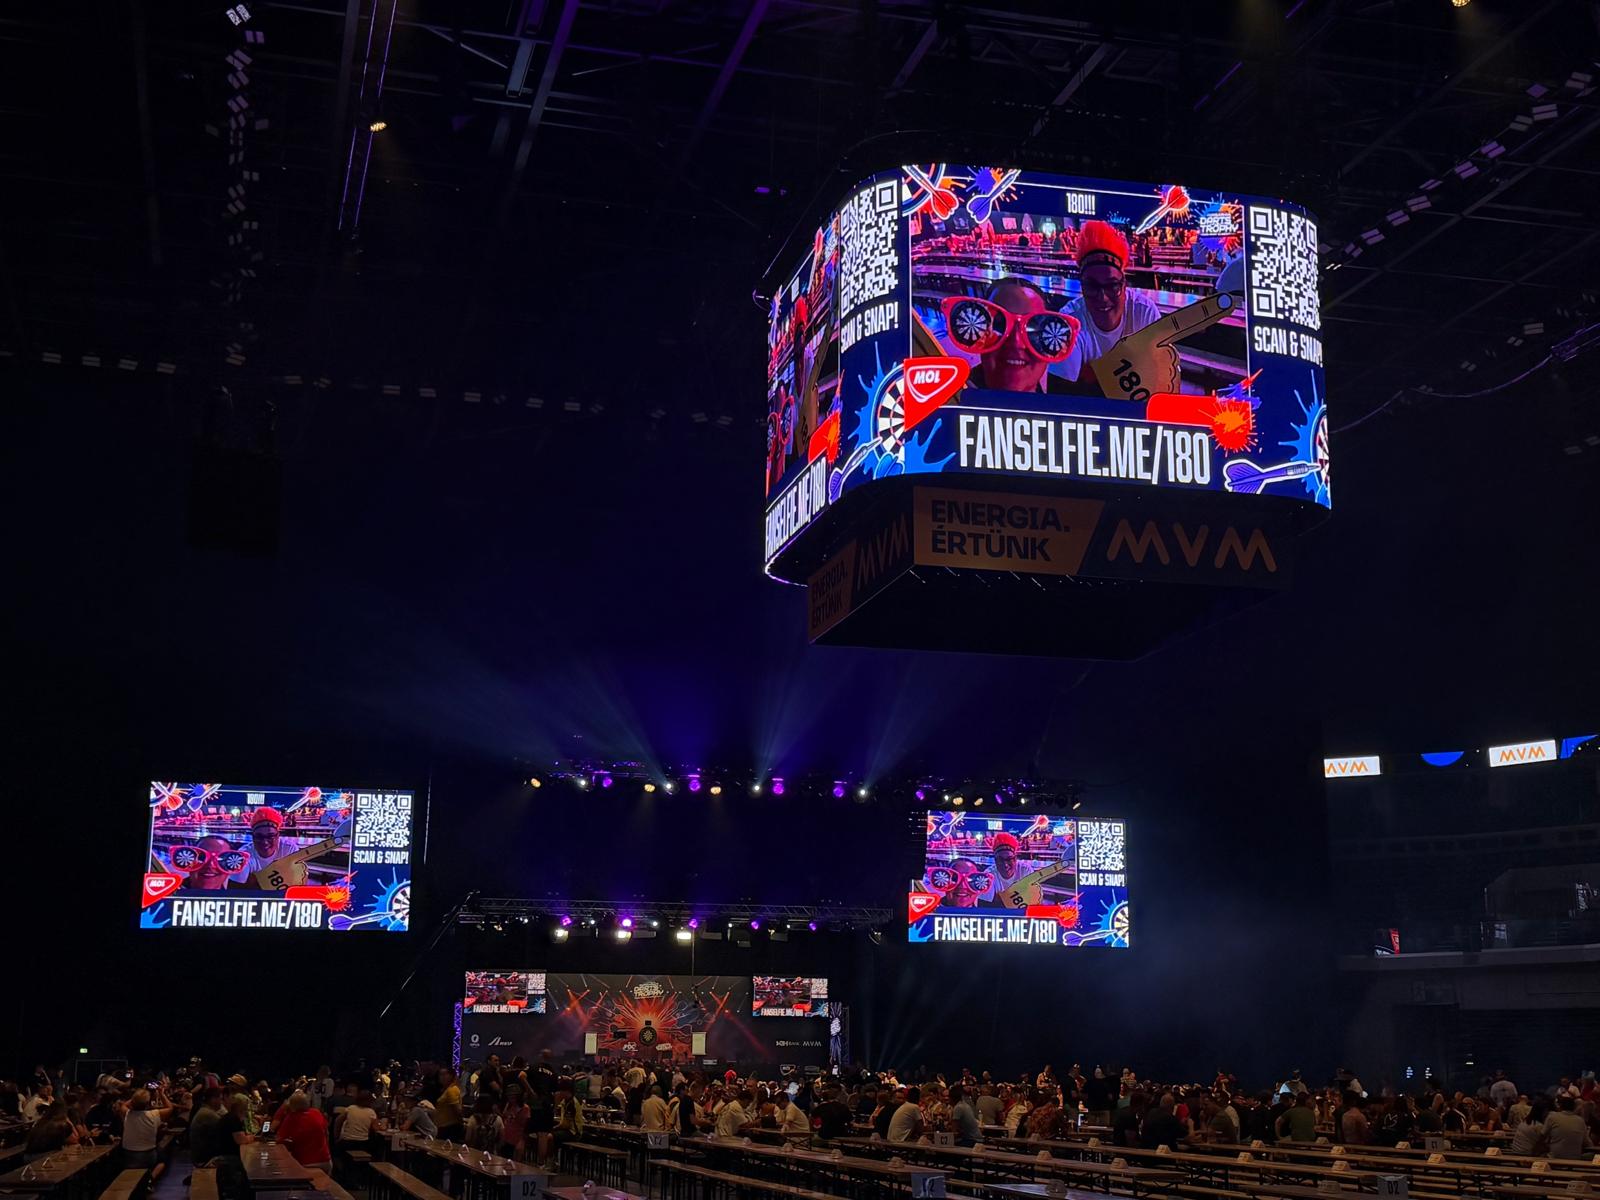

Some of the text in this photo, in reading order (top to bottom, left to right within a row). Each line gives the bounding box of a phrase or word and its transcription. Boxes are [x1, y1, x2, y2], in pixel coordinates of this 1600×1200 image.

[1066, 193, 1096, 217] 180!!!
[1200, 224, 1239, 234] TROPHY
[864, 301, 899, 338] SNAP!
[1254, 326, 1289, 355] SCAN
[1290, 331, 1298, 356] &
[913, 370, 941, 385] MOL
[959, 414, 1211, 485] FANSELFIE.ME/180
[931, 500, 1071, 533] ENERGIA.
[931, 525, 1051, 562] ÉRTÜNK
[1106, 518, 1278, 573] MVM
[1499, 744, 1546, 763] MVM
[354, 851, 375, 864] SCAN
[172, 900, 322, 929] FANSELFIE.ME/180
[934, 917, 1057, 944] FANSELFIE.ME/180
